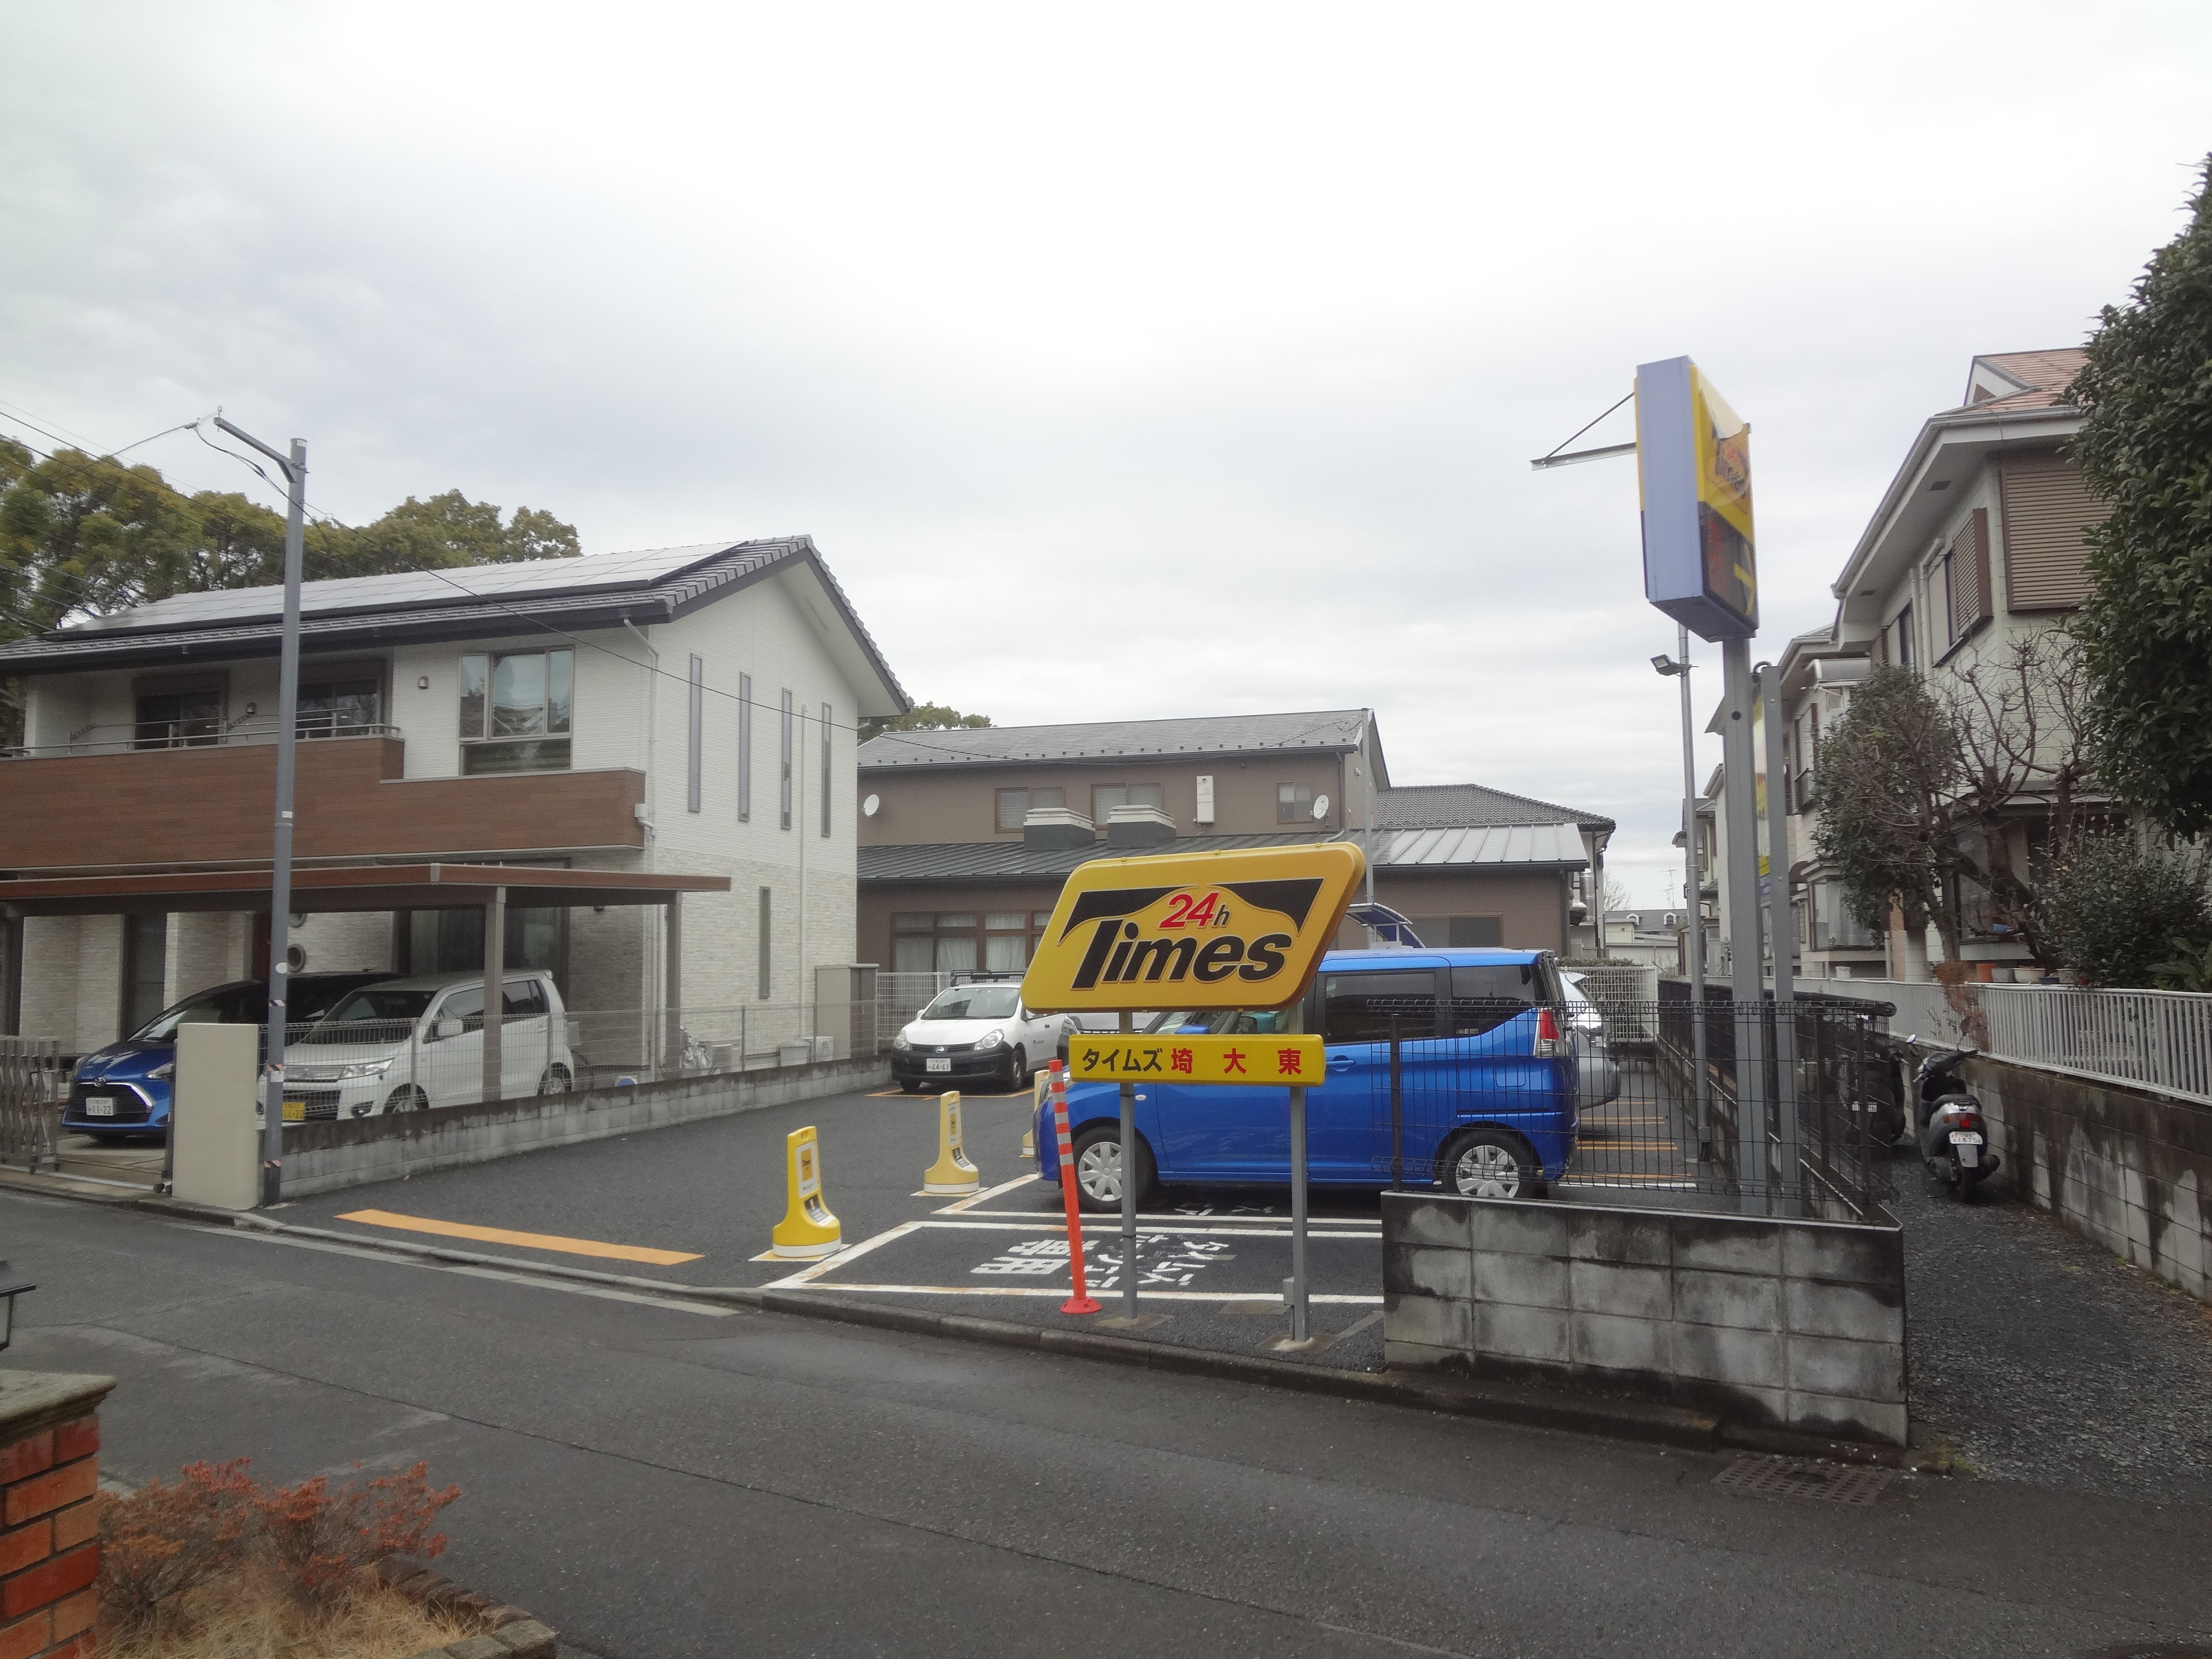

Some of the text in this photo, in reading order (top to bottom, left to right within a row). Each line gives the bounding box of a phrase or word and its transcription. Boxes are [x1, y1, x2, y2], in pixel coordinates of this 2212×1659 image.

[1158, 891, 1231, 929] 24h
[1071, 918, 1293, 989] Times
[1082, 1047, 1163, 1073] タイムズ
[93, 1105, 111, 1114] 11-22
